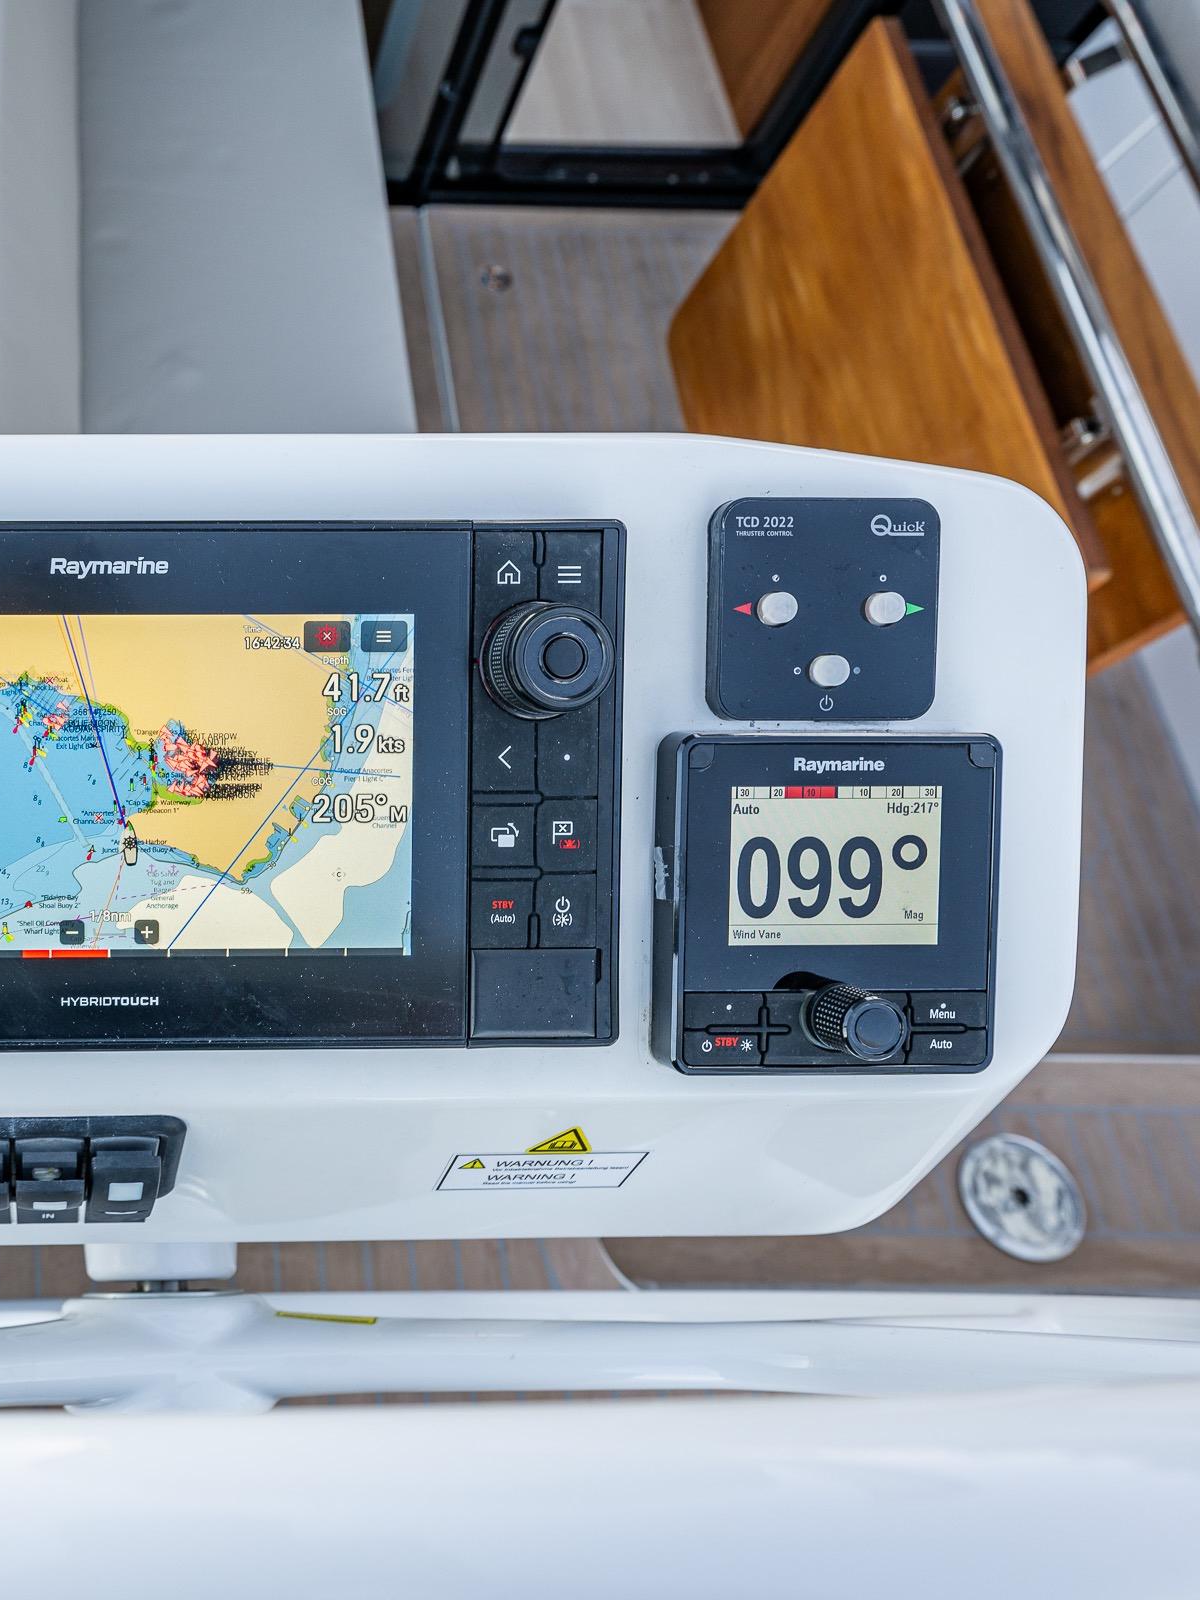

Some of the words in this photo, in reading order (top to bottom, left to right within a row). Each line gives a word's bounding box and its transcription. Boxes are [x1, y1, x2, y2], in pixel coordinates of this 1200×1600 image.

[736, 516, 760, 528] TCD
[763, 516, 794, 528] 2022
[870, 514, 925, 537] Quick
[50, 557, 169, 580] Raymarine
[244, 636, 300, 650] 16:42:34
[322, 656, 349, 667] Depth
[322, 672, 392, 702] 41.7
[394, 684, 409, 702] ft
[327, 707, 347, 716] SOG
[330, 724, 375, 754] 1.9
[377, 737, 405, 754] kts
[793, 757, 886, 774] Raymarine
[311, 777, 332, 786] COG
[740, 788, 750, 798] 30
[774, 788, 784, 798] 20
[806, 788, 816, 798] 10
[860, 788, 869, 798] 10
[892, 788, 902, 798] 20
[924, 788, 934, 798] 30
[390, 806, 408, 822] M
[733, 804, 760, 816] Auto
[887, 802, 939, 816] Hdg:217°
[736, 834, 928, 920] 099°
[492, 900, 514, 910] STBY
[89, 910, 132, 923] 1/8nm
[490, 913, 516, 924] (Auto)
[904, 910, 924, 922] Mag
[732, 930, 756, 940] Wind
[758, 930, 782, 940] Vane
[60, 996, 159, 1006] HYBRIDTOUCH
[929, 1009, 956, 1020] Menu
[714, 1036, 738, 1047] STBY
[930, 1040, 952, 1050] Auto
[496, 1160, 583, 1168] WARNUNG
[486, 1174, 566, 1182] WARNING
